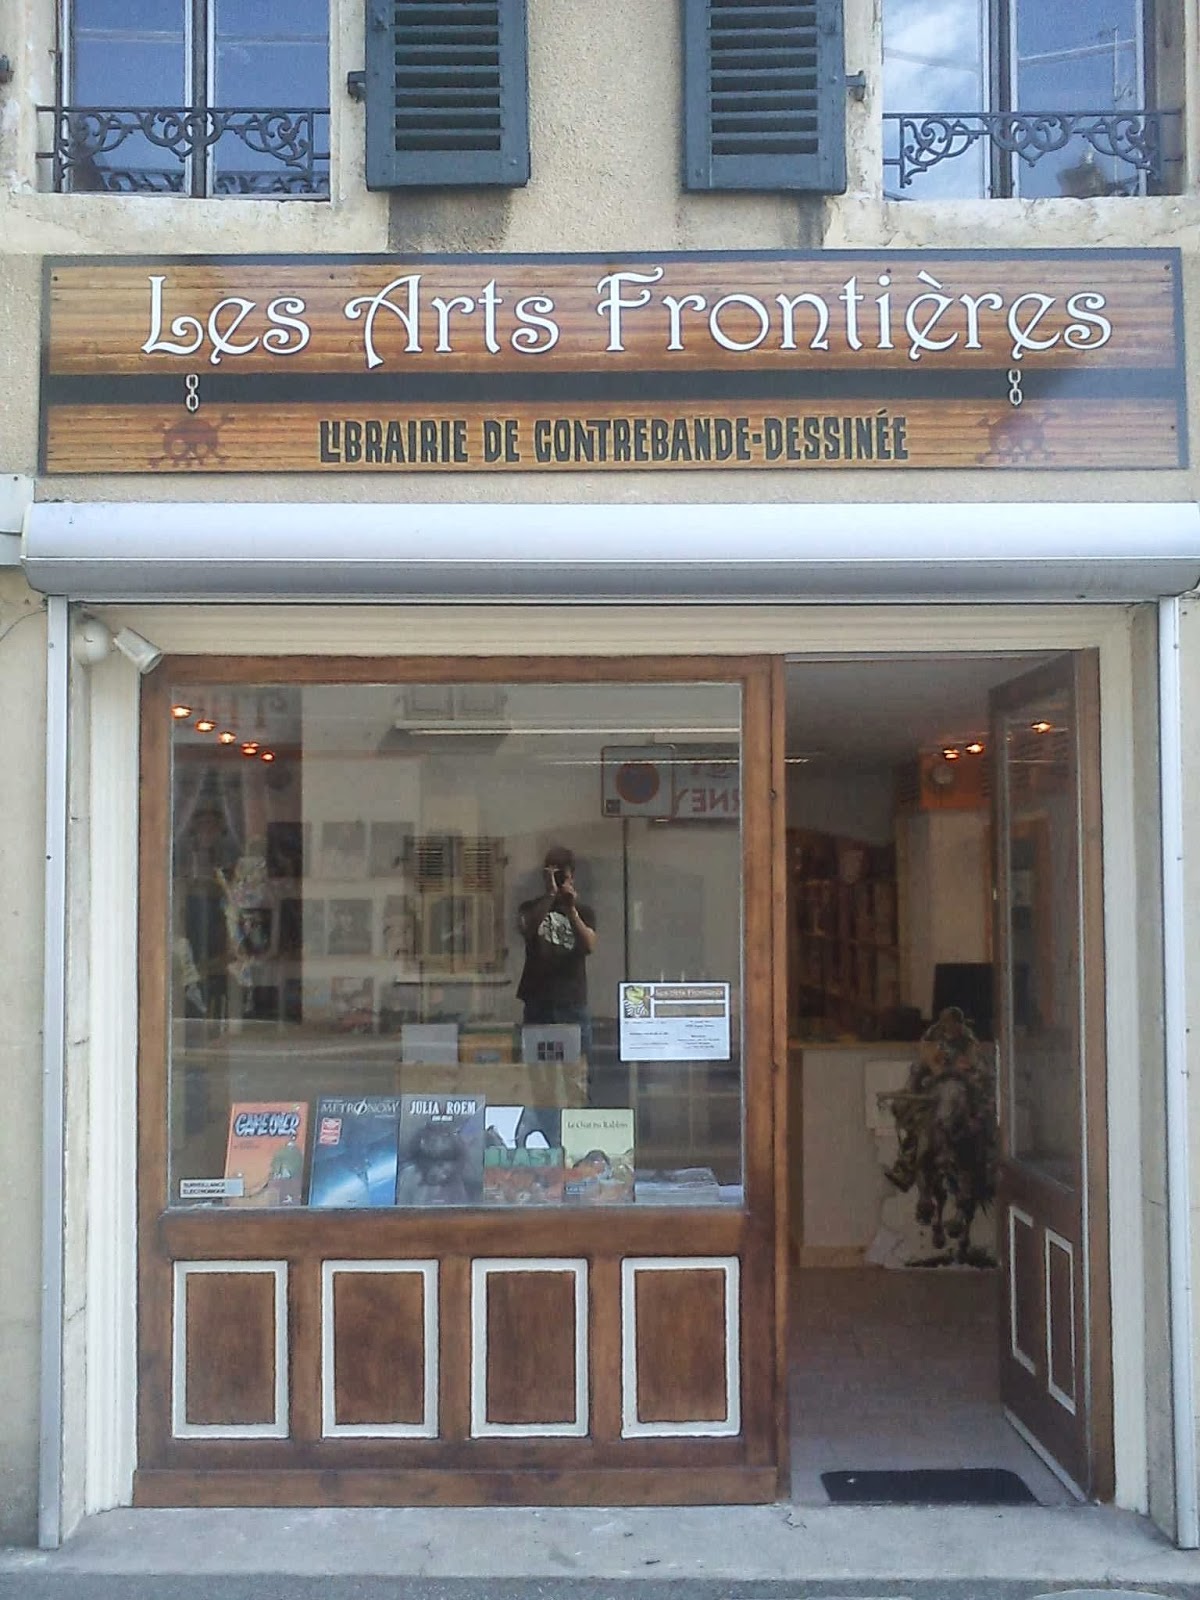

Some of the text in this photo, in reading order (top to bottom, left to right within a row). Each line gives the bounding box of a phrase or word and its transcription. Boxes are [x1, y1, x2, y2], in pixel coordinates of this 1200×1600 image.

[140, 266, 1113, 369] Les Arts Frontières
[319, 419, 468, 463] LIBRAIRIE
[483, 419, 521, 463] DE
[410, 1100, 476, 1115] JULIA ROEM
